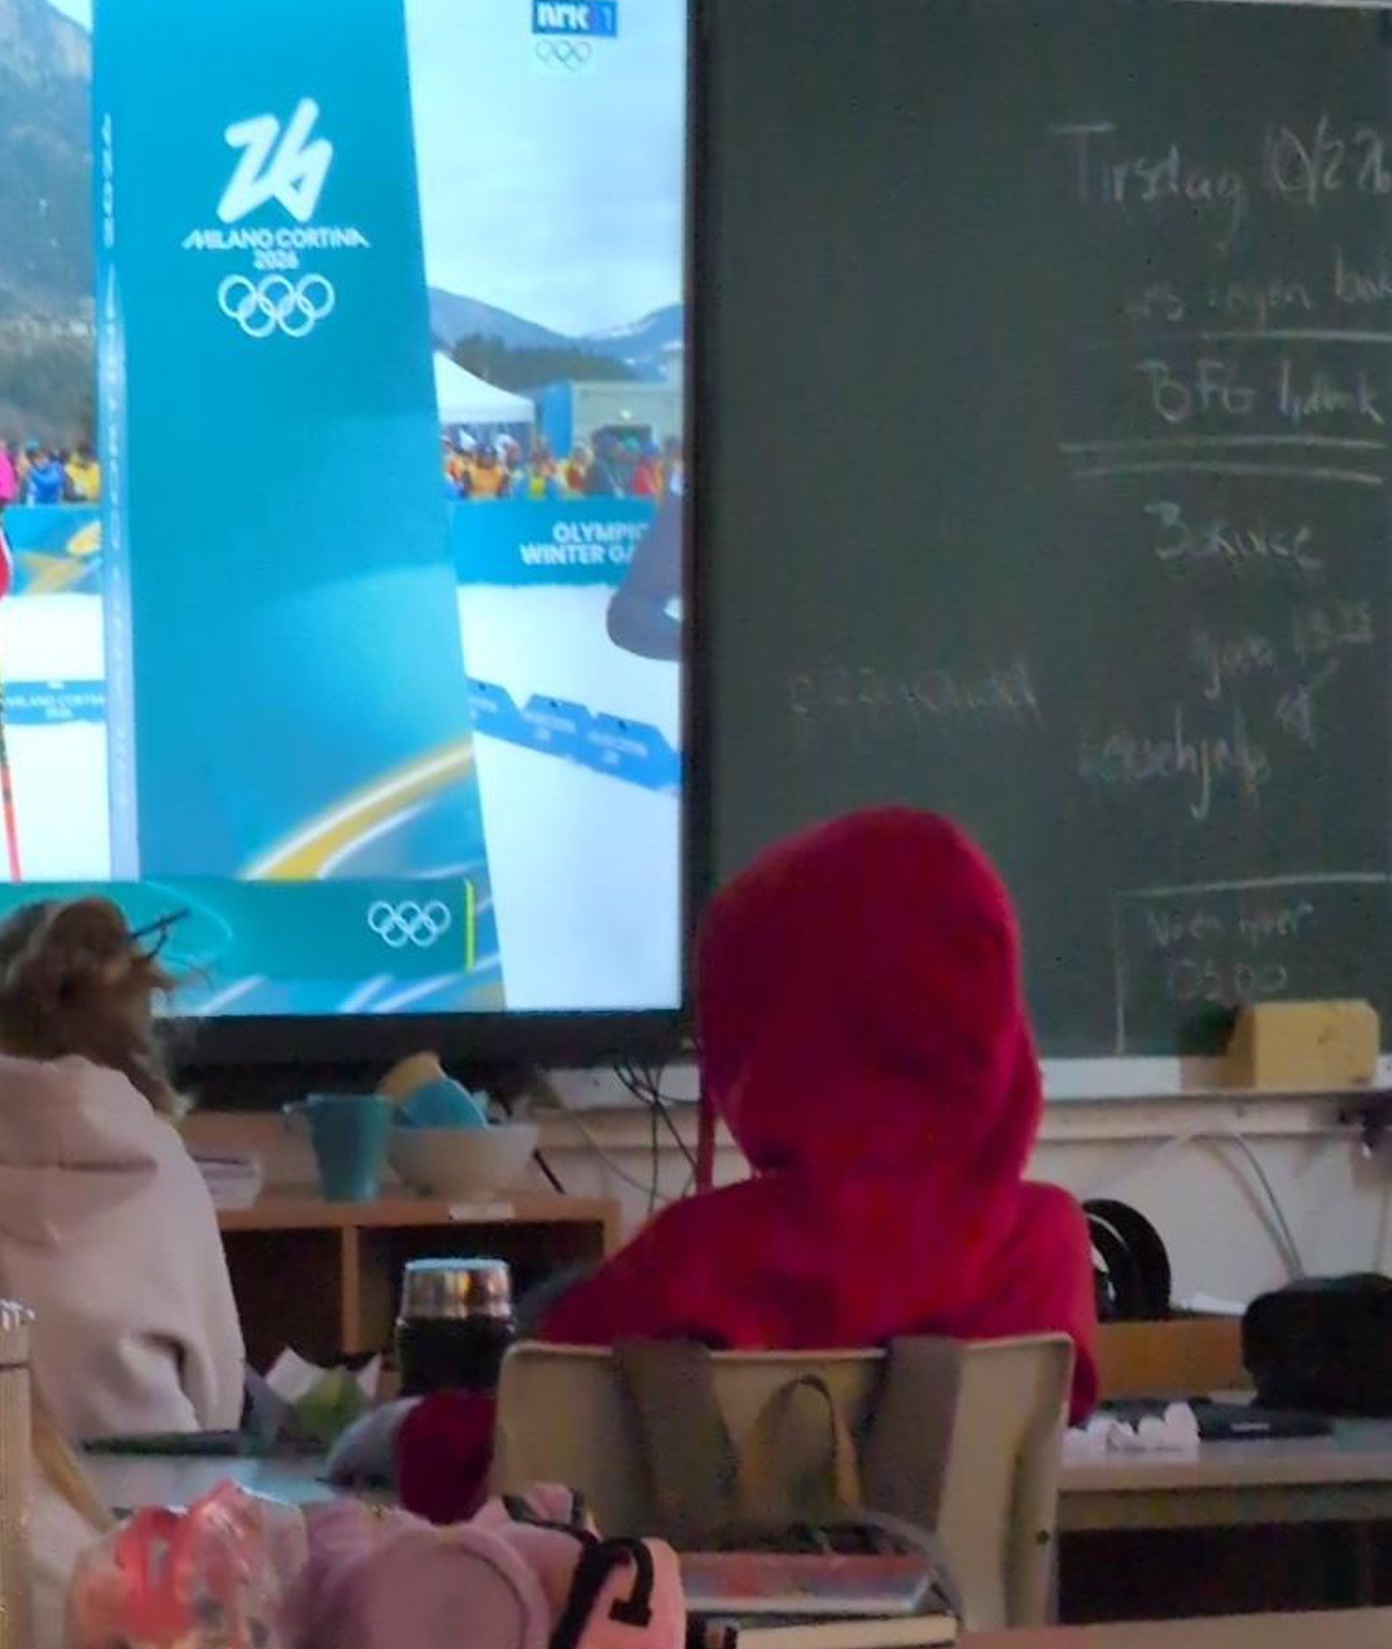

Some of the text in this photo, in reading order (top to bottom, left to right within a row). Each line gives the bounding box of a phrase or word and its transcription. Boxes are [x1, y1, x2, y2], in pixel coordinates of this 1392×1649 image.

[181, 226, 372, 251] MILANO CORTINA
[519, 543, 606, 566] WINTER
